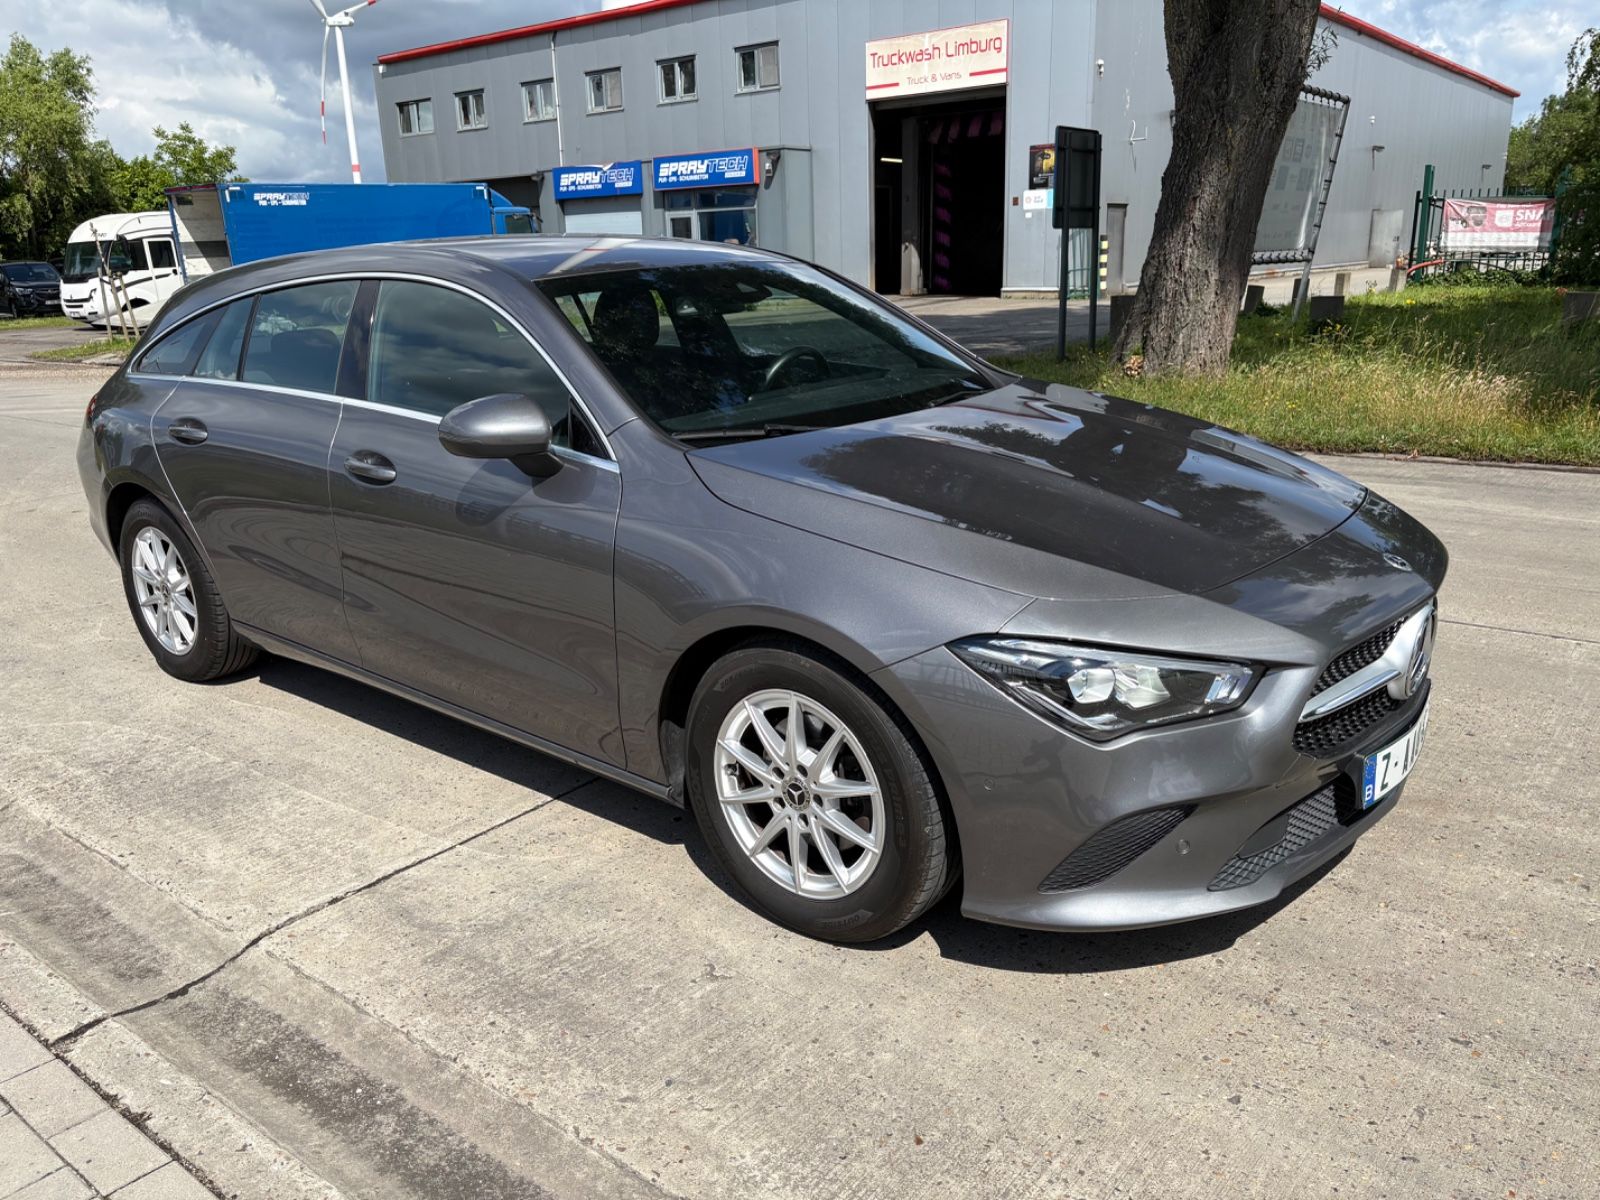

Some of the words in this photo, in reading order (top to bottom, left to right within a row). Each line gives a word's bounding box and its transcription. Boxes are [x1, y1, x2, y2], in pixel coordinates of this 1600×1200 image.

[870, 44, 941, 69] Truckwash
[945, 37, 1003, 58] Limburg
[906, 75, 929, 86] Truck
[930, 73, 937, 82] &
[940, 71, 962, 82] Vans
[659, 155, 748, 176] SPRAYTECH
[1365, 784, 1373, 800] B
